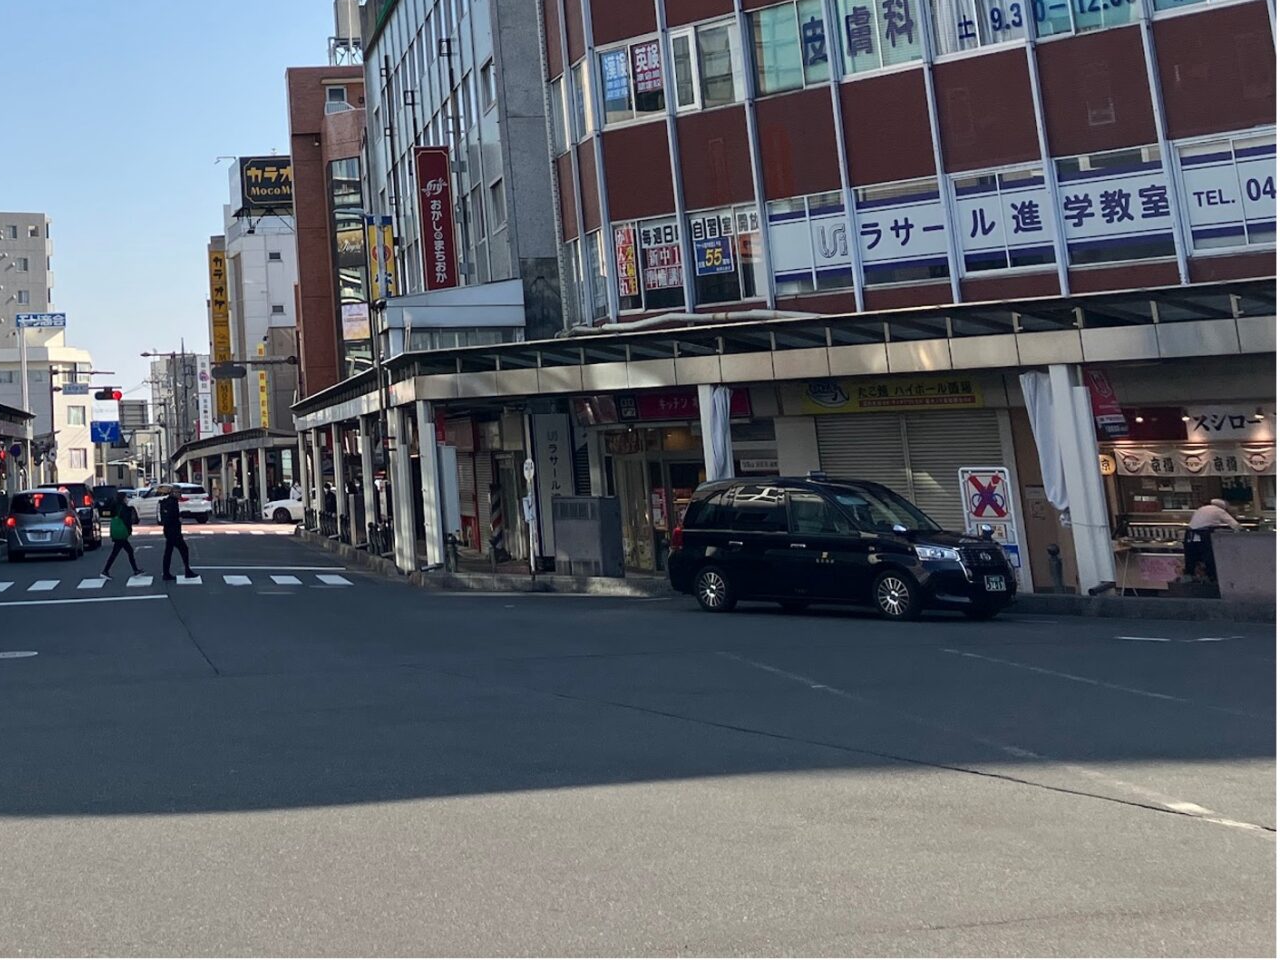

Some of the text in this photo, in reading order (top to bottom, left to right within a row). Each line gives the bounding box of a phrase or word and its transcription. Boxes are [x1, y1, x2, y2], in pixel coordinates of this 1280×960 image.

[1193, 188, 1236, 210] TEL.
[860, 185, 1171, 250] ラサール進学教室
[642, 224, 678, 246] 毎週日
[705, 247, 723, 267] 55
[213, 256, 226, 311] カラオケ
[1193, 413, 1263, 432] スシロー
